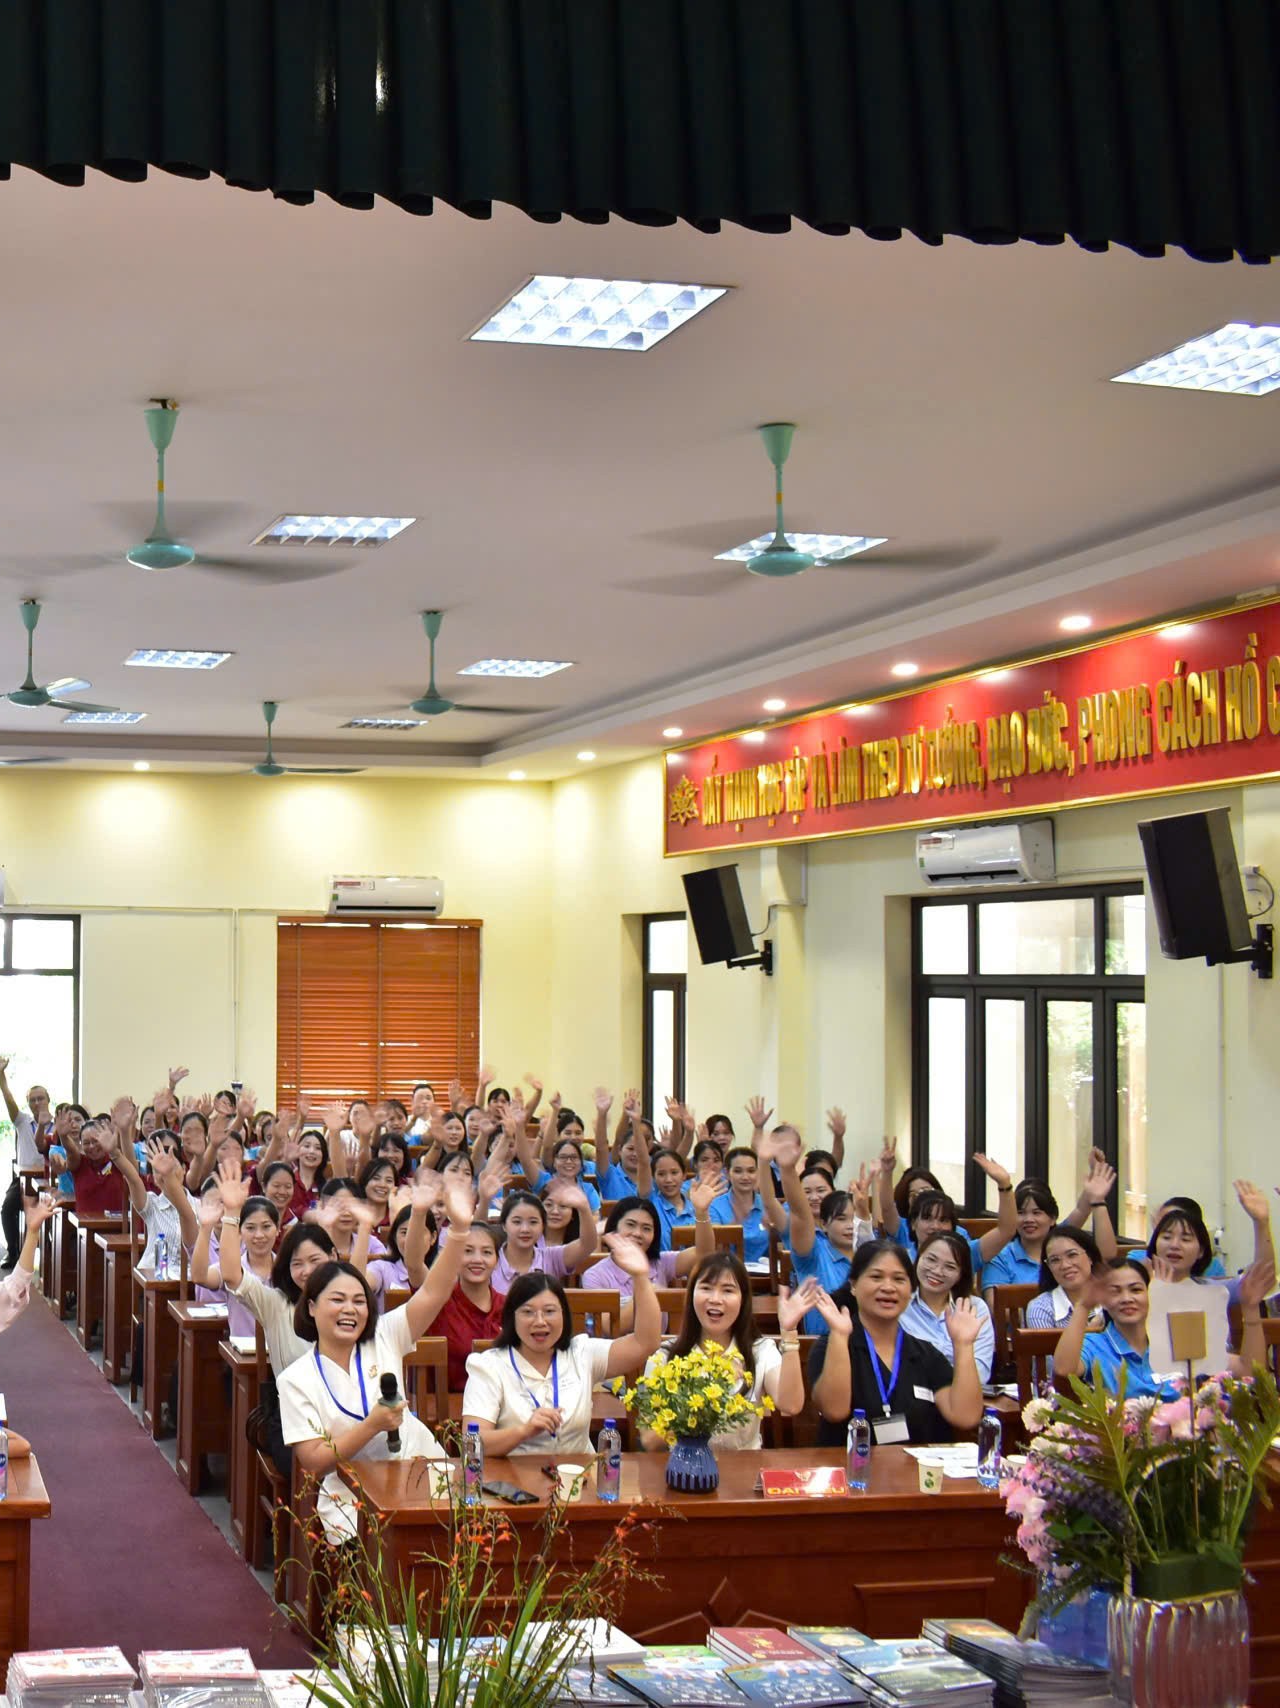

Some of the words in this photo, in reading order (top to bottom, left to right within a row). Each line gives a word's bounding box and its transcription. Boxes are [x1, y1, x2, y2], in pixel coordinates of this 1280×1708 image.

[757, 762, 785, 827] HỌC
[784, 746, 808, 824] TẬP
[811, 741, 830, 808] VÀ
[830, 736, 862, 805] LÀM
[861, 737, 900, 800] THEO
[901, 725, 925, 794] TƯ
[1077, 683, 1153, 765] PHONG
[1156, 660, 1221, 752] CÁCH
[1224, 633, 1262, 742] HỒ
